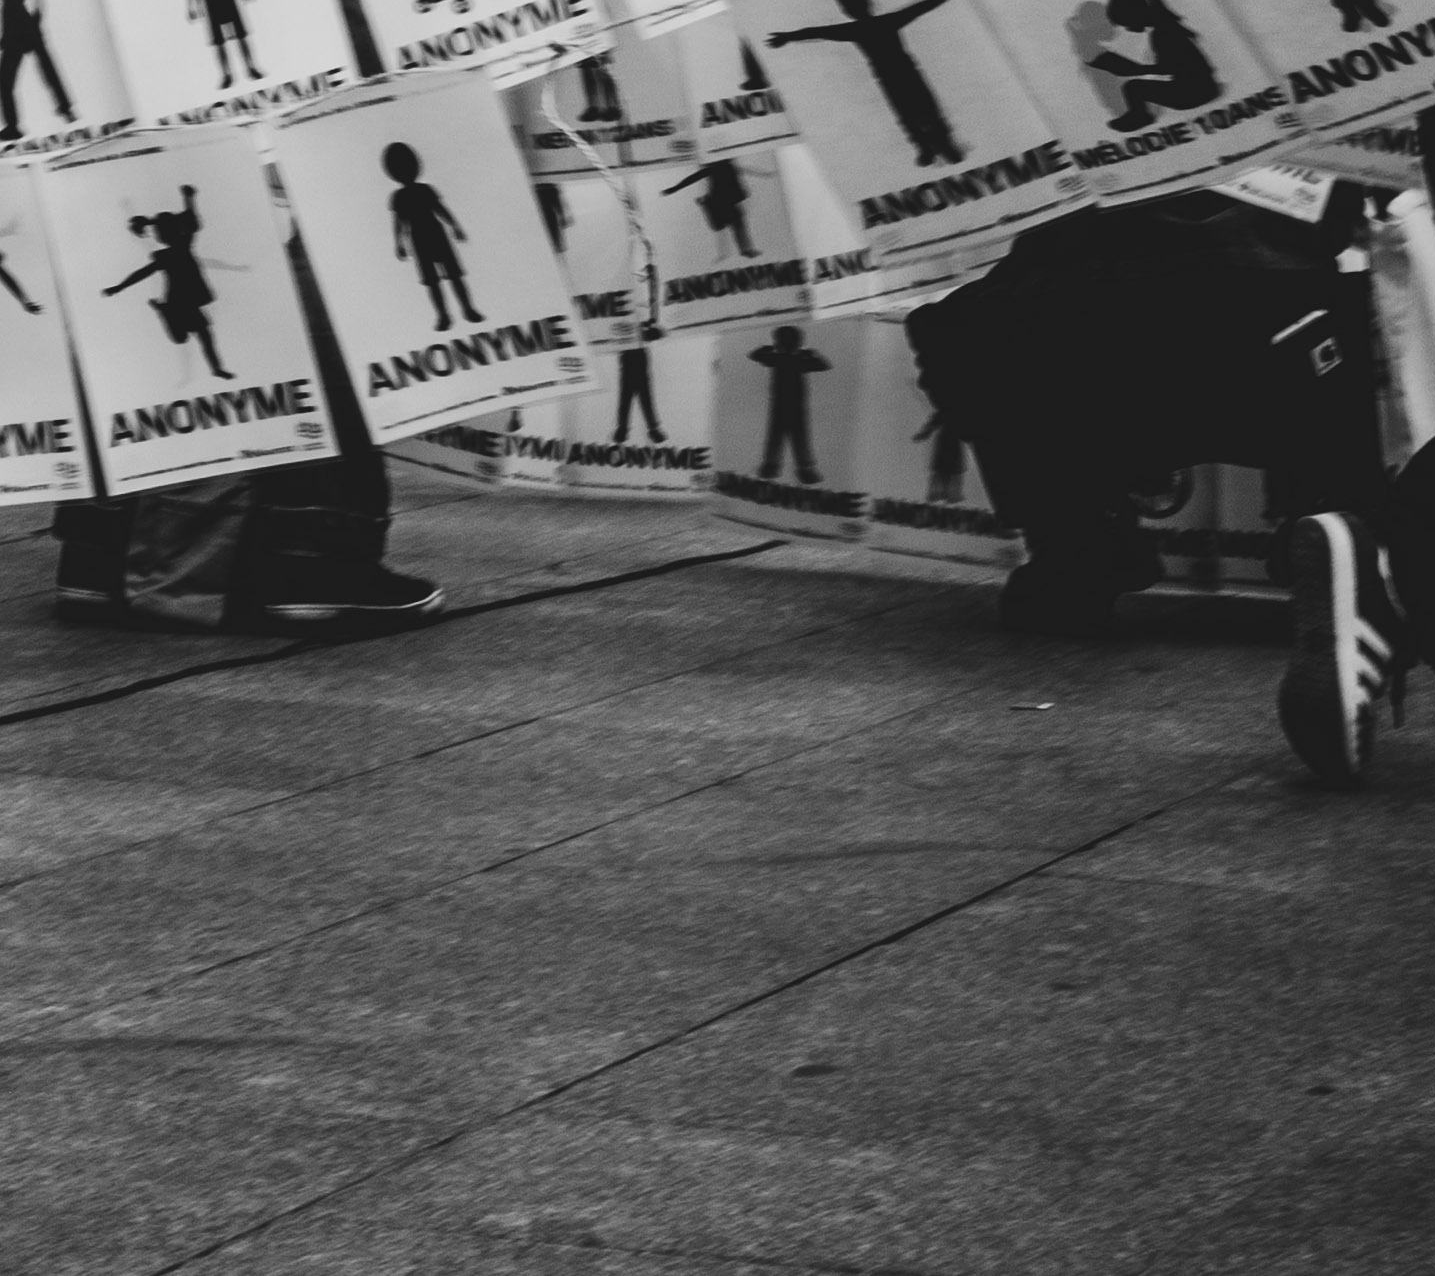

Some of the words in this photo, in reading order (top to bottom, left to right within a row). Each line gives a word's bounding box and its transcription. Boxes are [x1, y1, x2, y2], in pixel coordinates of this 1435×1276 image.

[857, 139, 1073, 231] ANONYME
[367, 314, 576, 398] ANONYME
[110, 377, 317, 448] ANONYME
[567, 442, 713, 471] ANONYME
